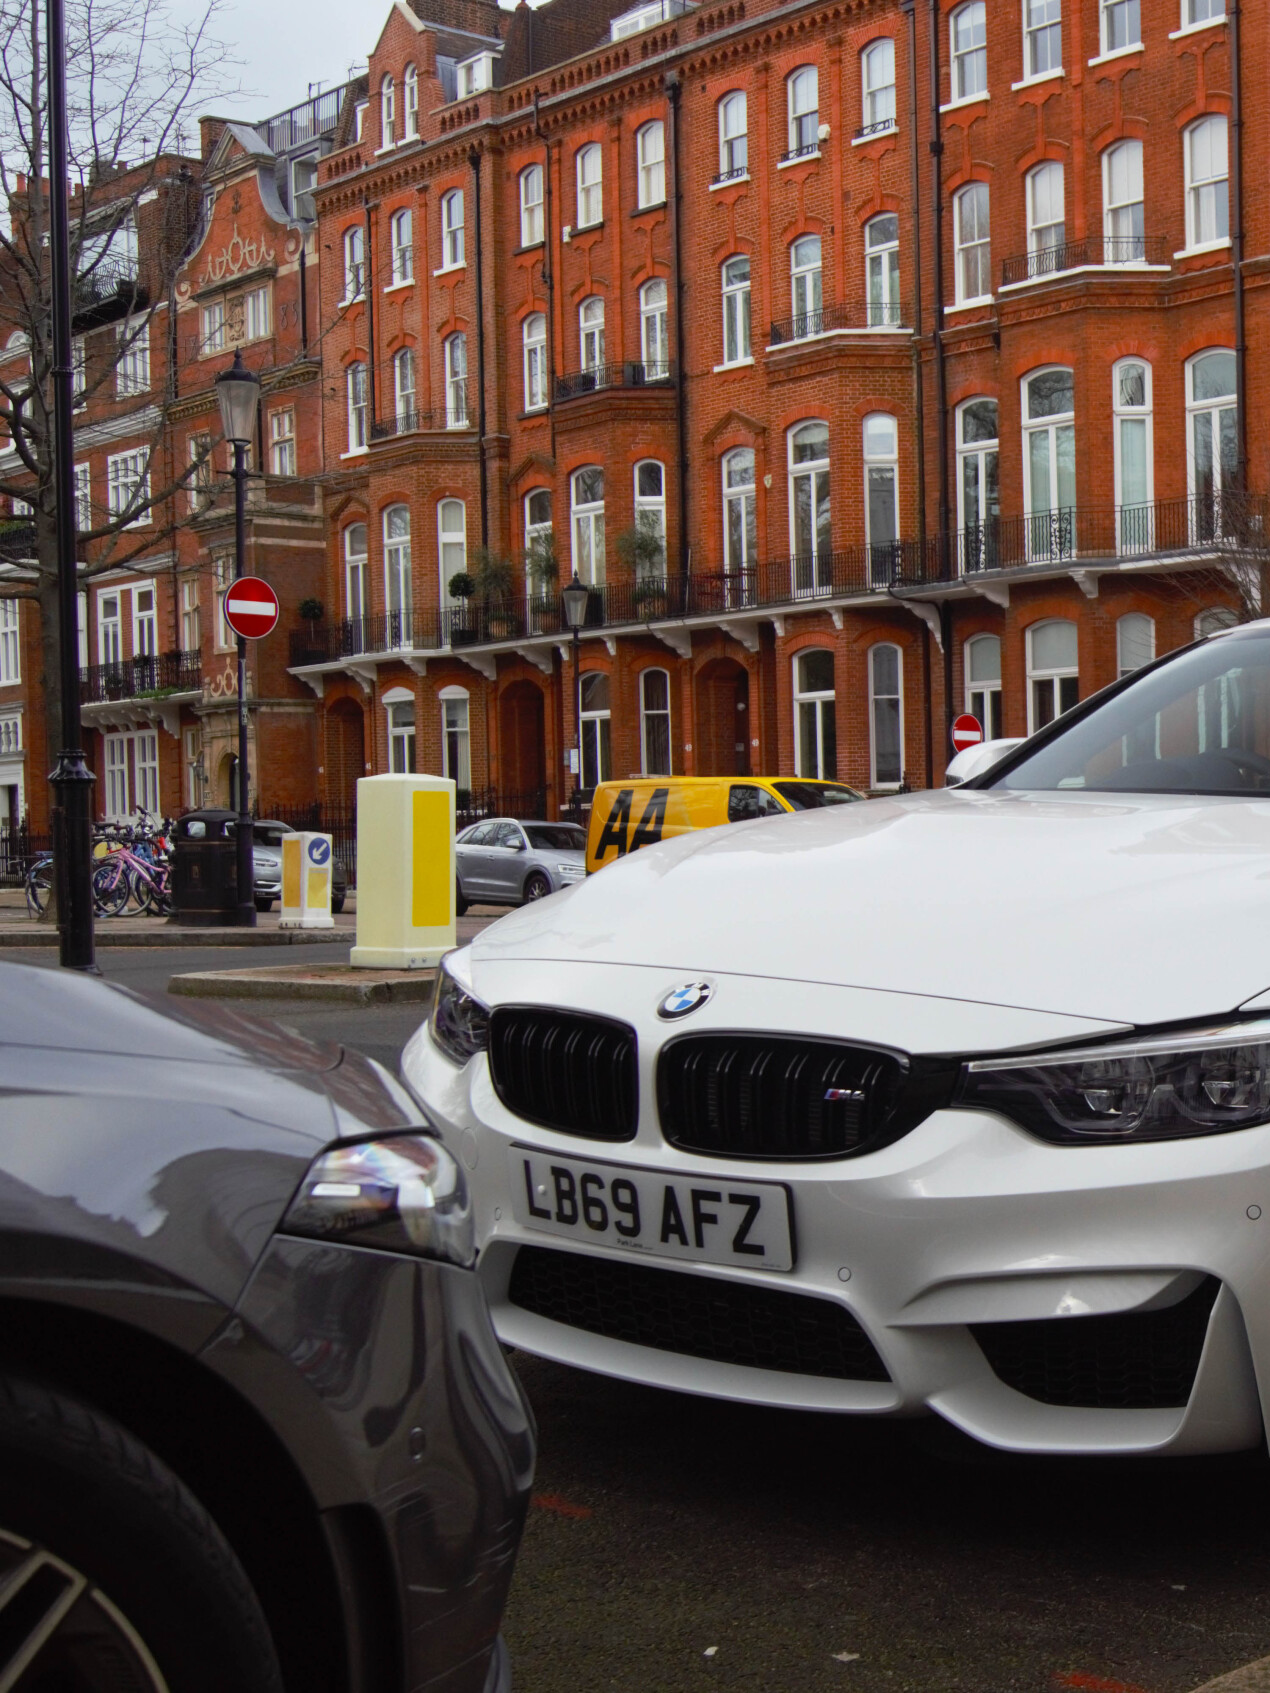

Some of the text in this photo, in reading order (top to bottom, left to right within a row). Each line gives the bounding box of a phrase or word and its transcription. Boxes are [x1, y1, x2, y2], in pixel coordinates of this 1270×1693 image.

[594, 788, 670, 860] AA
[523, 1159, 766, 1256] LB69 AFZ
